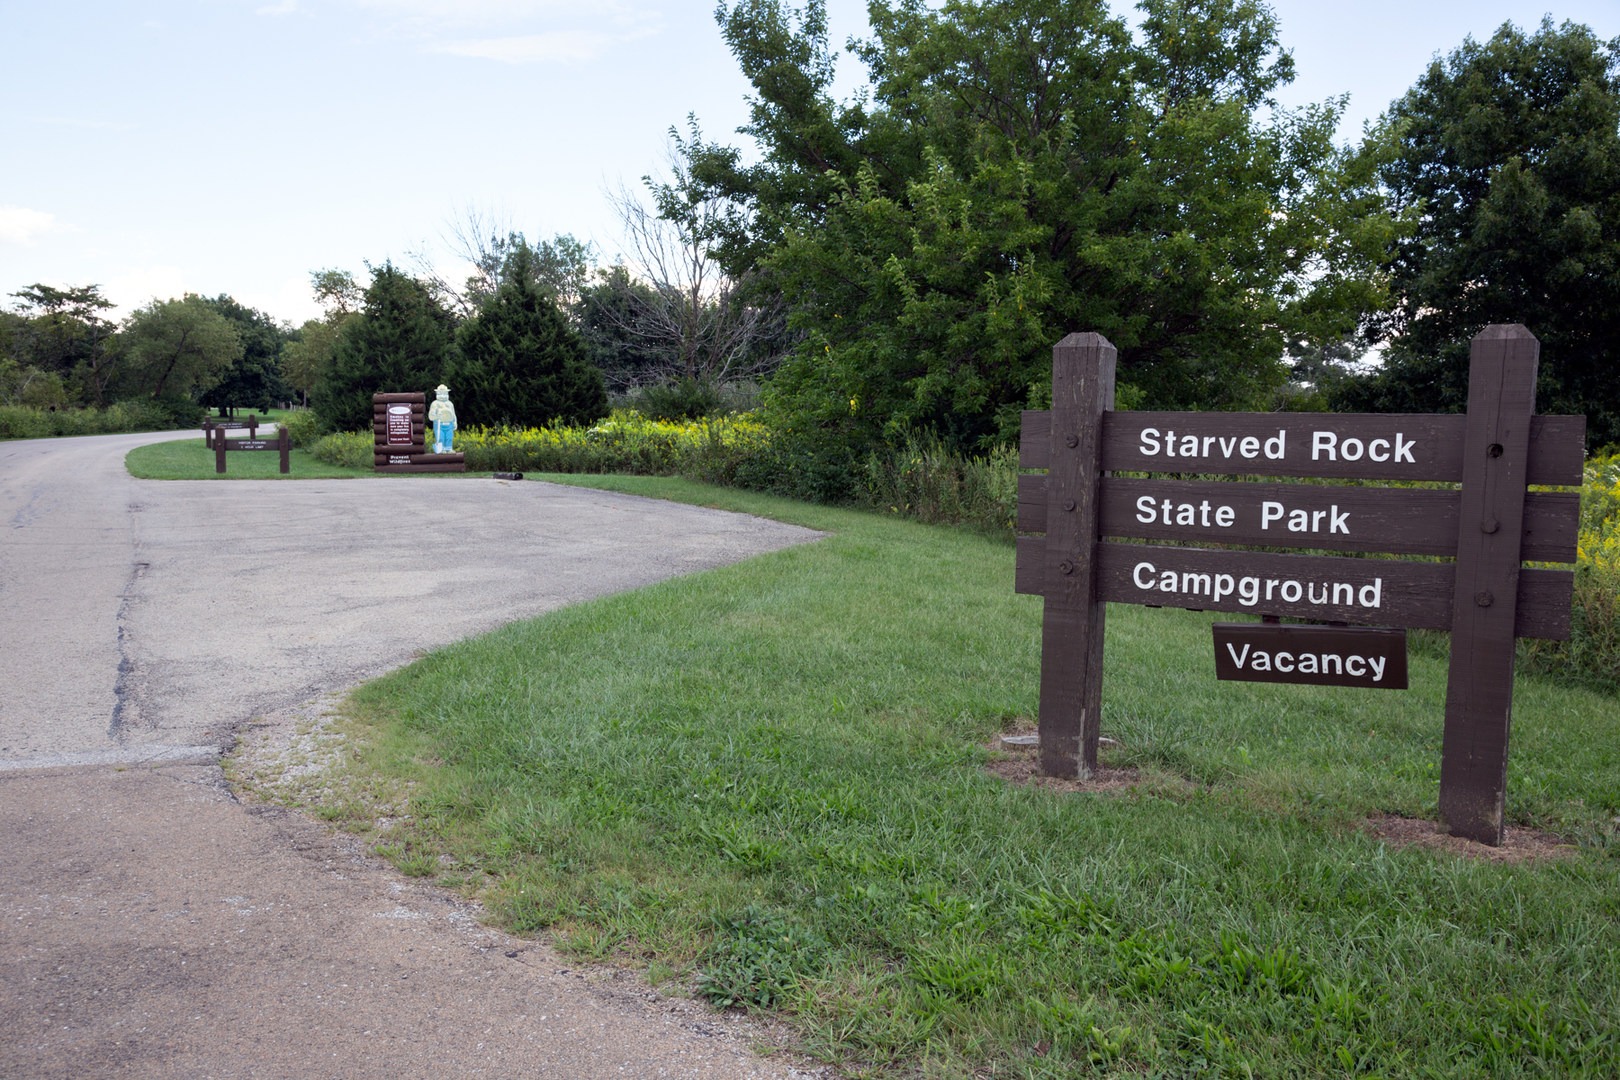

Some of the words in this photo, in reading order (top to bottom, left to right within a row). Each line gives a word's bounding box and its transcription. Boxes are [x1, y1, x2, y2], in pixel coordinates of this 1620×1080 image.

[1139, 428, 1286, 460] Starved
[1311, 431, 1416, 463] Rock
[1136, 495, 1235, 527] State
[1261, 501, 1351, 534] Park
[1132, 562, 1382, 608] Campground
[1226, 642, 1386, 682] Vacancy
